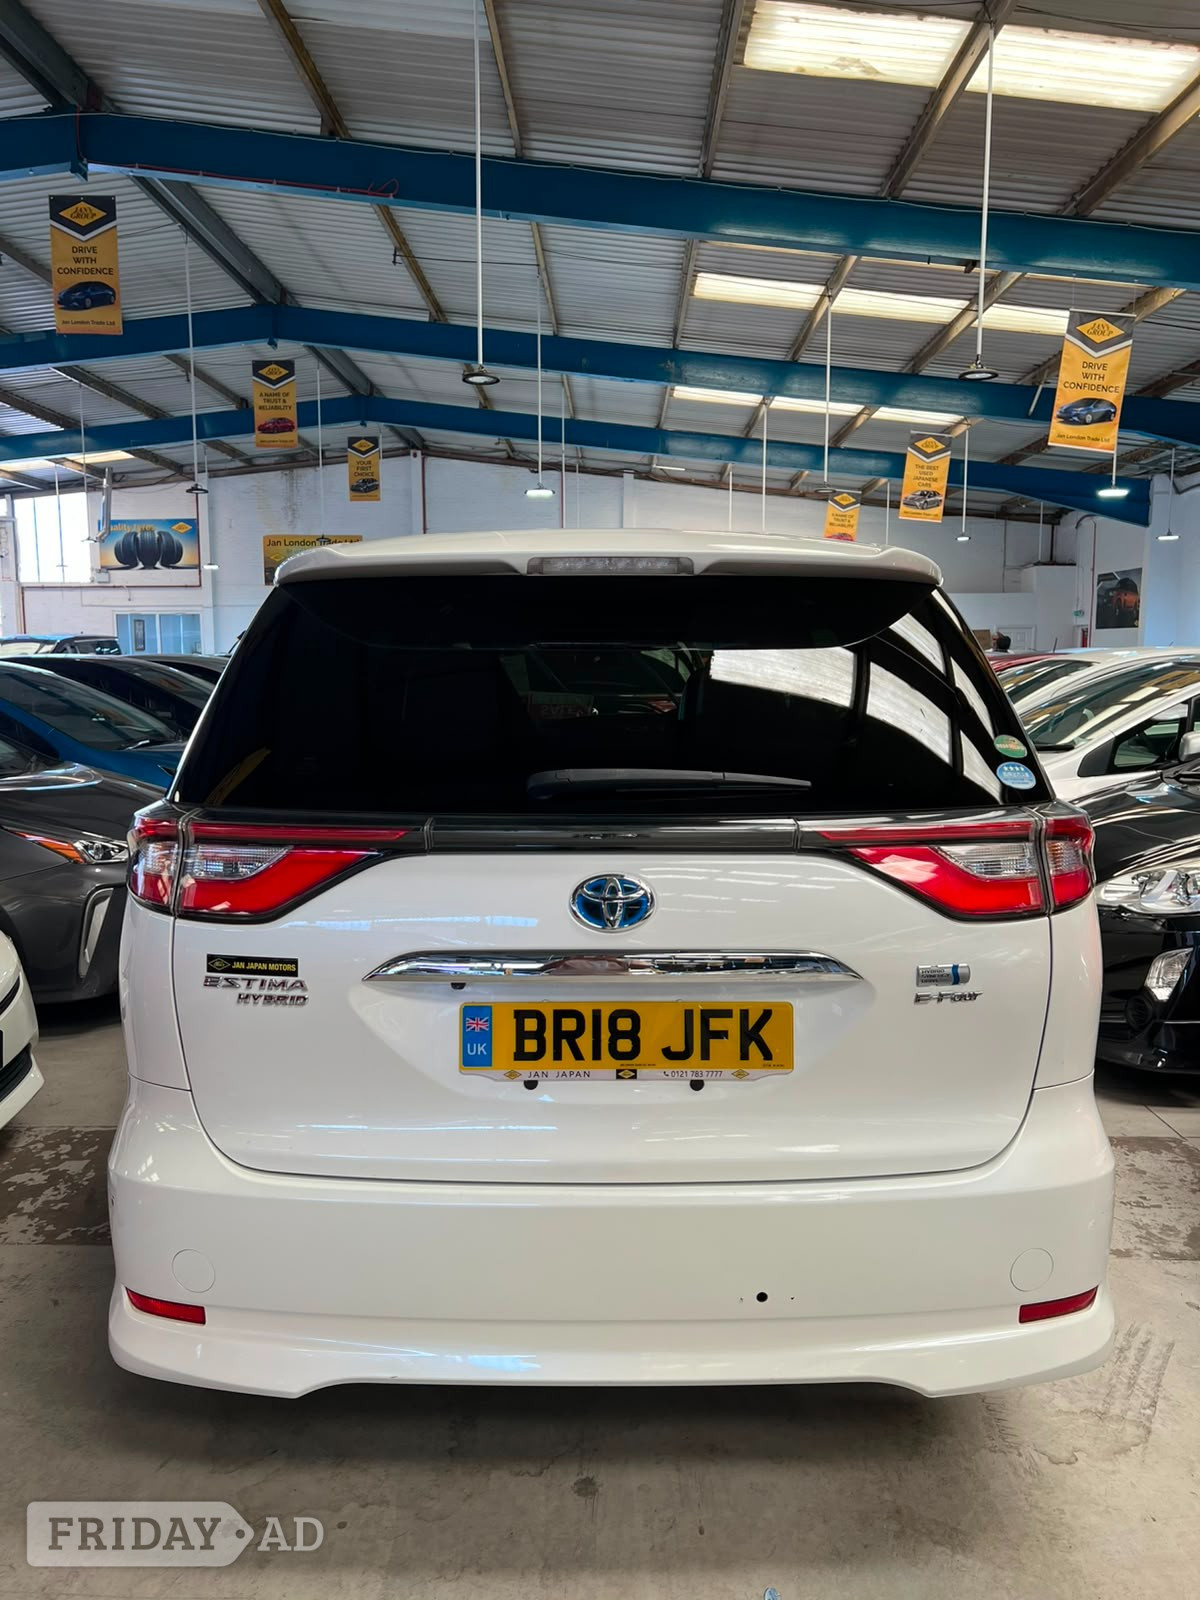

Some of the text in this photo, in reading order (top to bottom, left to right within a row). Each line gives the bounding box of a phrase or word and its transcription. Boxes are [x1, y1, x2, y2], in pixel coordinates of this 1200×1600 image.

[71, 246, 98, 254] DRIVE
[73, 257, 97, 265] WITH
[57, 267, 114, 276] CONFIDENCE
[1086, 328, 1114, 337] GROUP
[1081, 361, 1108, 371] DRIVE
[1081, 372, 1105, 381] WITH
[1063, 381, 1120, 393] CONFIDENCE
[266, 539, 282, 547] Jan
[283, 538, 316, 547] London
[232, 961, 245, 969] JAN
[246, 962, 267, 970] JAPAN
[268, 963, 297, 972] MOTORS
[203, 976, 308, 992] ESTIMA
[237, 993, 309, 1006] HYBRID
[513, 1009, 773, 1061] BR18 JFK
[467, 1043, 487, 1056] UK
[527, 1070, 591, 1078] JAN JAPAN
[670, 1070, 723, 1078] 0121 783 7777
